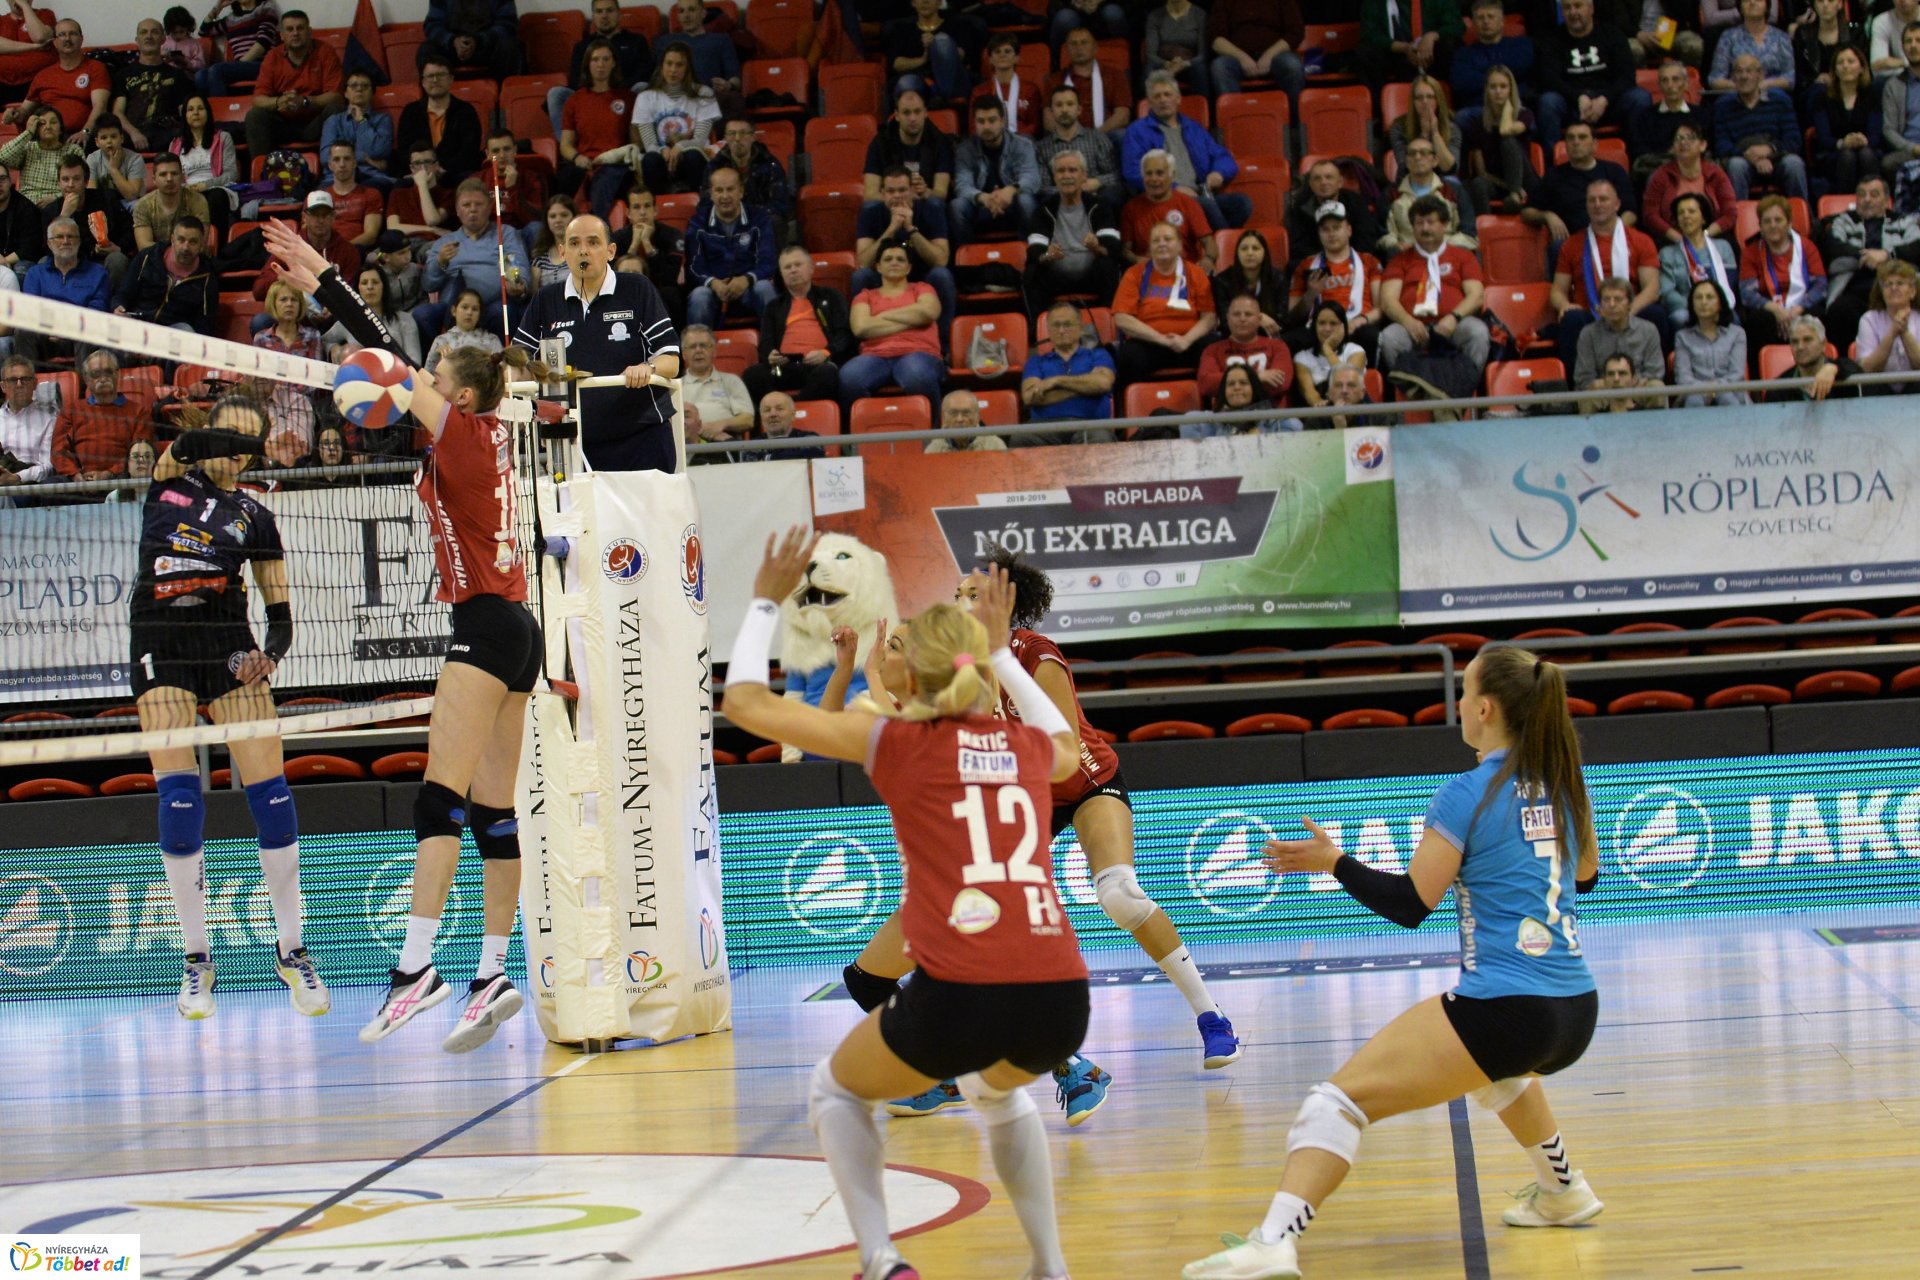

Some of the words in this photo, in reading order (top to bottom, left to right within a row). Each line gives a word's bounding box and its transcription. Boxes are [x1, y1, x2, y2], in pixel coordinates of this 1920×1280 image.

[334, 274, 366, 307] sport
[364, 307, 388, 335] unit
[556, 320, 575, 329] Zeus
[1733, 449, 1816, 469] MAGYAR
[1006, 493, 1047, 504] 2018-2019
[1103, 486, 1204, 507] RÖPLABDA
[1661, 470, 1895, 515] RÖPLABDA
[199, 498, 218, 523] 1
[1727, 515, 1832, 538] SZÖVETSÉG
[973, 521, 1036, 558] NŐI
[1043, 517, 1237, 554] EXTRALIGA
[2, 552, 78, 570] MAGYAR
[1729, 578, 1761, 589] magyar
[1762, 574, 1799, 586] röplabda
[1800, 571, 1843, 584] szövetség
[1864, 564, 1920, 579] www.hunvolle
[0, 572, 140, 611] PLABD
[1588, 585, 1629, 598] hunvolley
[1658, 579, 1701, 592] Hunvolley
[1144, 611, 1174, 621] magyar
[1175, 605, 1212, 617] röplabda
[1213, 601, 1256, 614] szövetség
[1277, 599, 1352, 613] www.hunvolley.hu
[1073, 613, 1115, 627] Hunvolley
[450, 643, 471, 653] JAKO
[139, 652, 155, 681] 1
[27, 674, 62, 685] röplabda
[63, 672, 103, 683] szövetség
[961, 752, 1015, 773] FATUM
[1101, 787, 1121, 796] JAKO
[1523, 807, 1555, 829] FATU
[951, 784, 1048, 884] 12
[1533, 839, 1564, 925] 7
